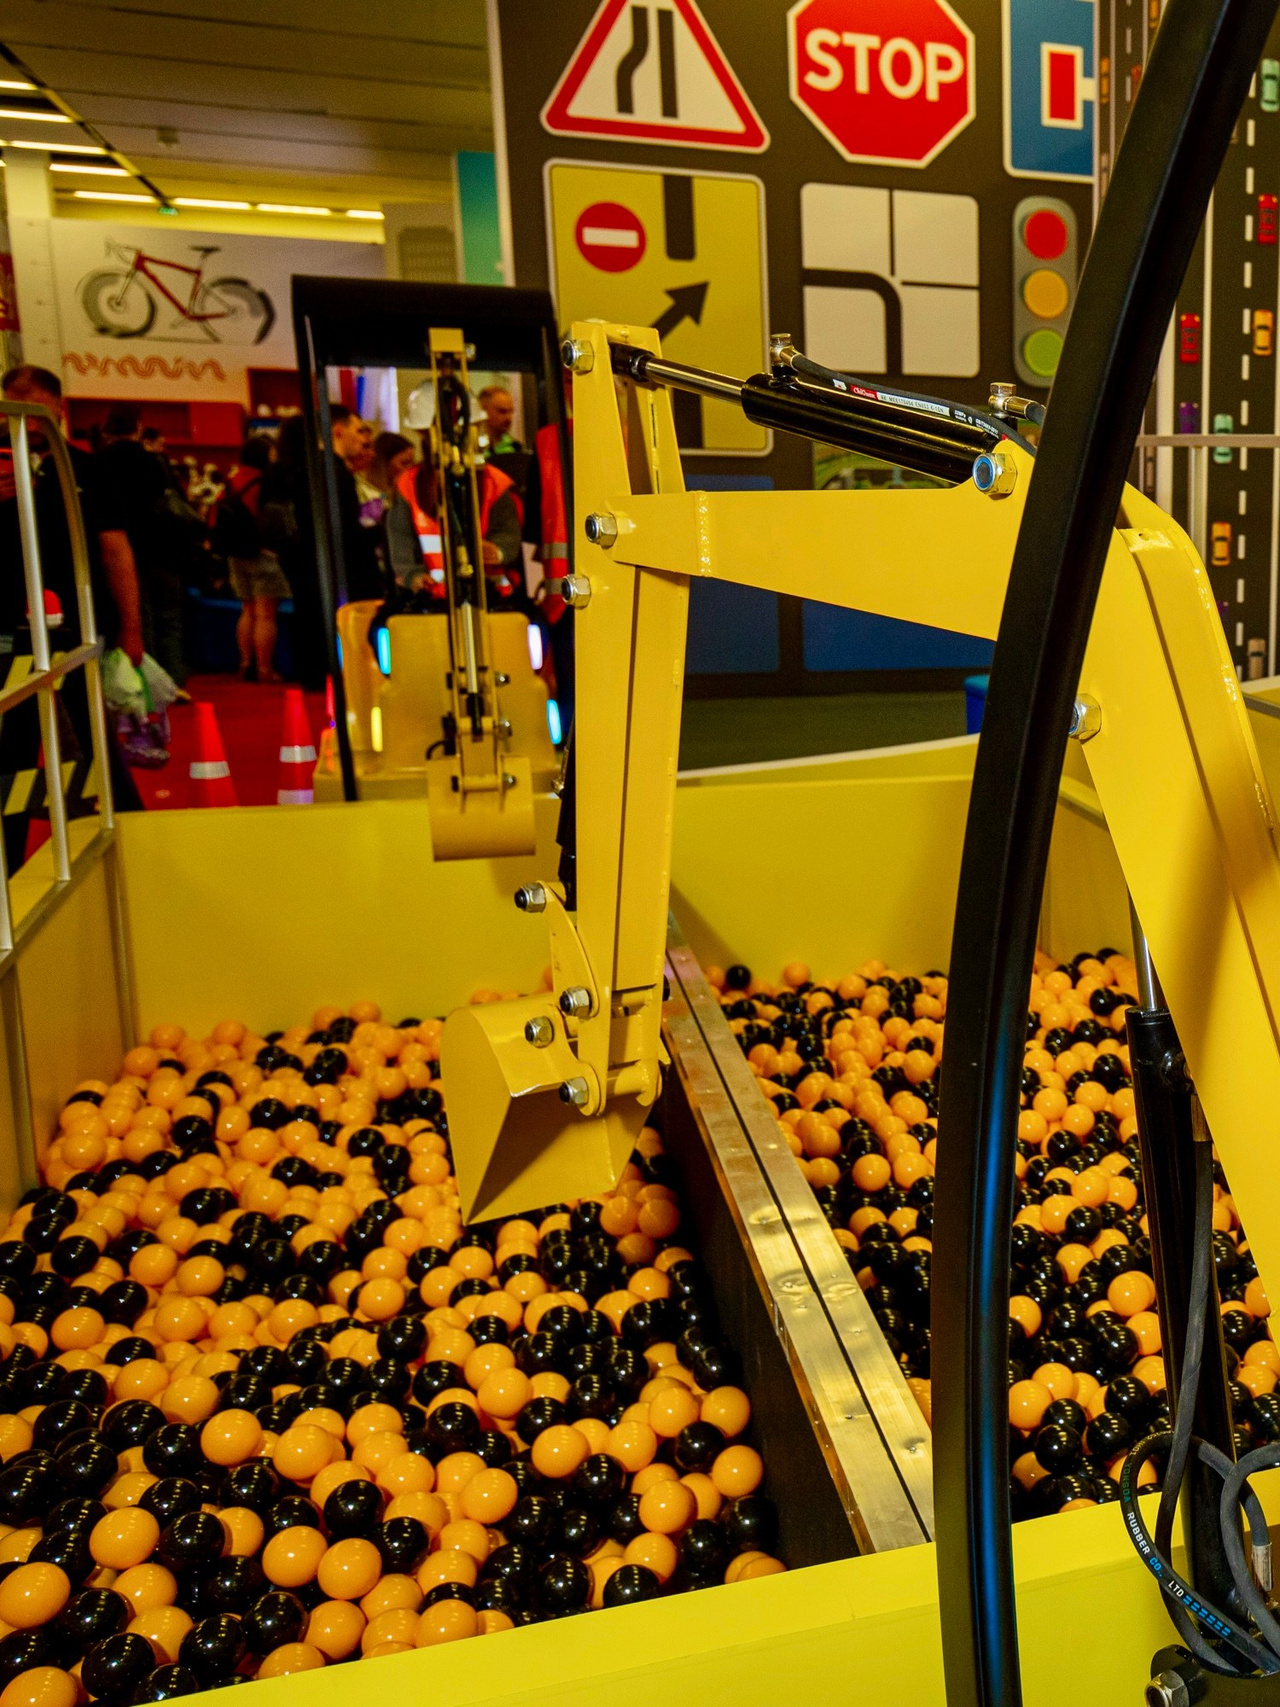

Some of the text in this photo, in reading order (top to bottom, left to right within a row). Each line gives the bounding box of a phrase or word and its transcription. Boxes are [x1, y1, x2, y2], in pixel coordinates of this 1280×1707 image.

[803, 27, 964, 103] STOP
[1127, 1512, 1151, 1555] RUBBER
[1168, 1580, 1185, 1597] LTD
